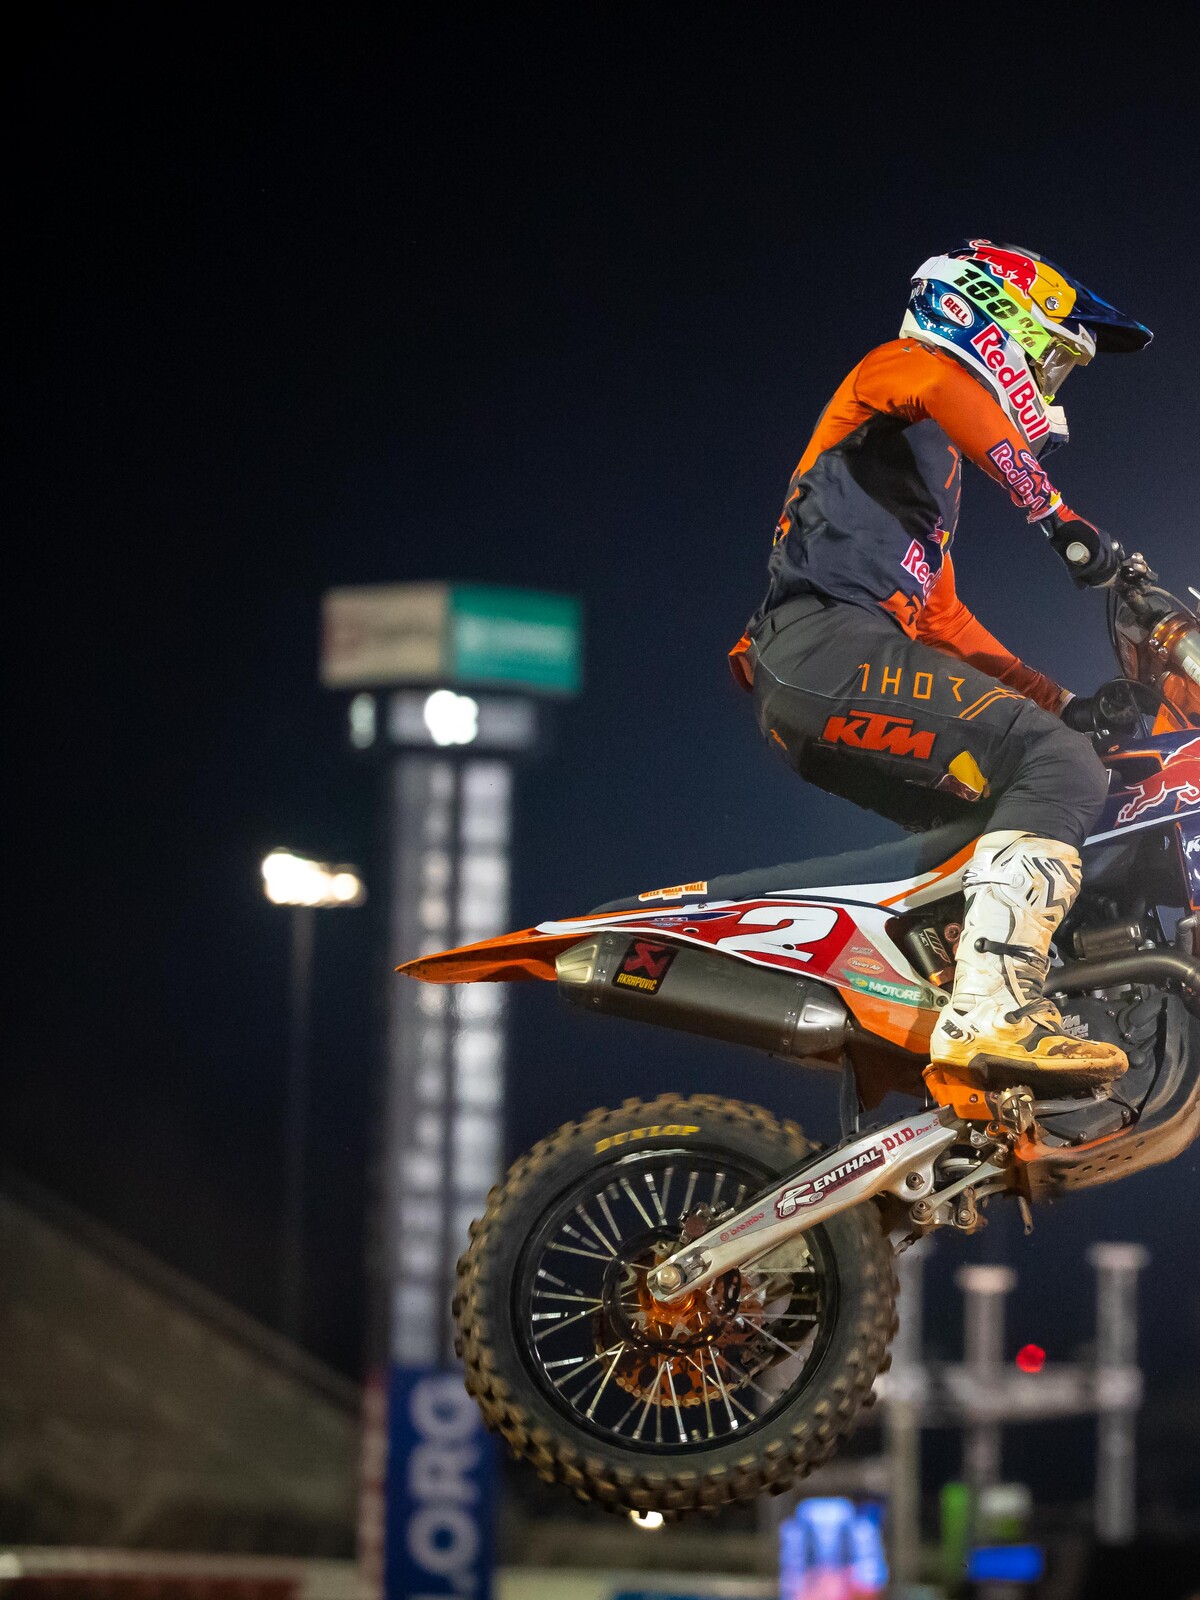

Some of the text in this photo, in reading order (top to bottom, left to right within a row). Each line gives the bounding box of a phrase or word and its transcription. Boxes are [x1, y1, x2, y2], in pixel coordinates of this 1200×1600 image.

[943, 296, 970, 326] BELL
[953, 269, 1045, 349] 100%
[971, 322, 1052, 444] Red Bull
[822, 709, 936, 760] KTM
[715, 905, 840, 962] 2
[594, 1124, 700, 1155] DUNLOP
[730, 1212, 765, 1236] brembo
